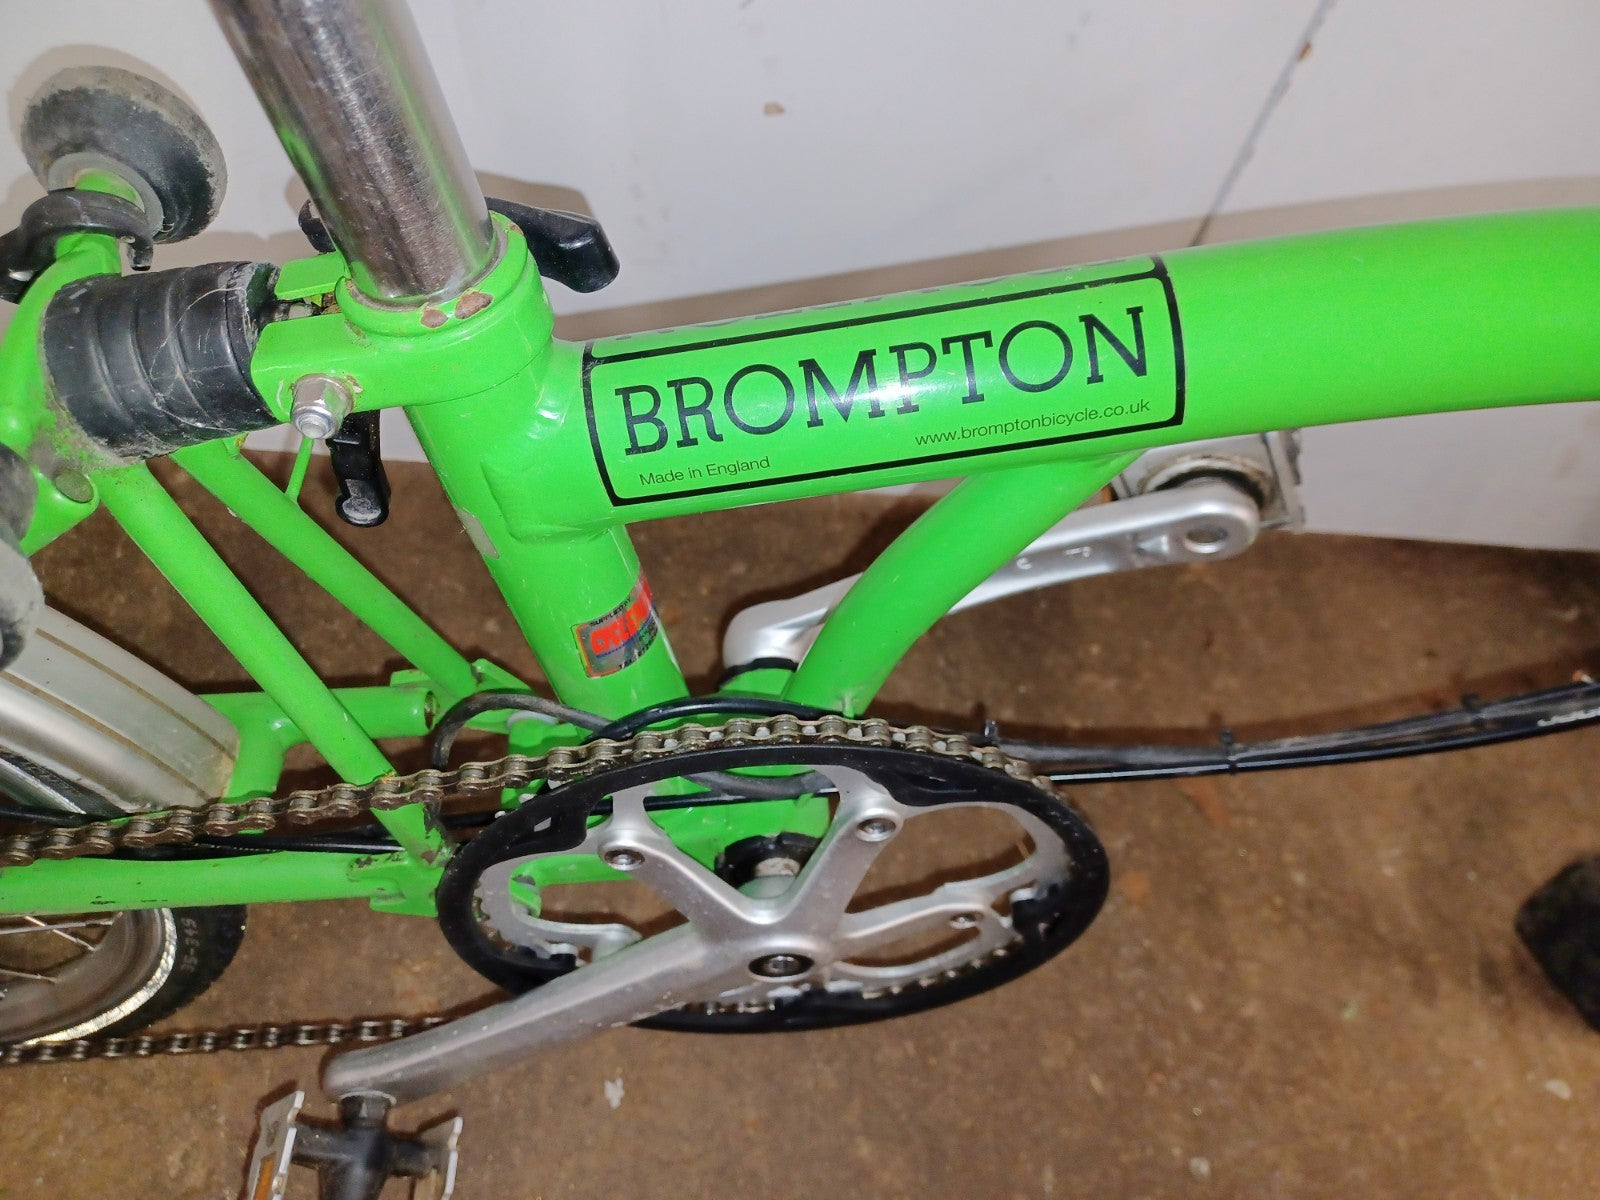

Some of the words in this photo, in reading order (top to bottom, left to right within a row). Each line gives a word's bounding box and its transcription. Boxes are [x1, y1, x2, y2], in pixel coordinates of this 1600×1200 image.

[614, 305, 1148, 456] BROMPTON
[914, 399, 1151, 446] www.bromptonbicycle.co.uk
[639, 470, 685, 486] Made
[688, 466, 703, 480] in
[706, 455, 771, 477] England
